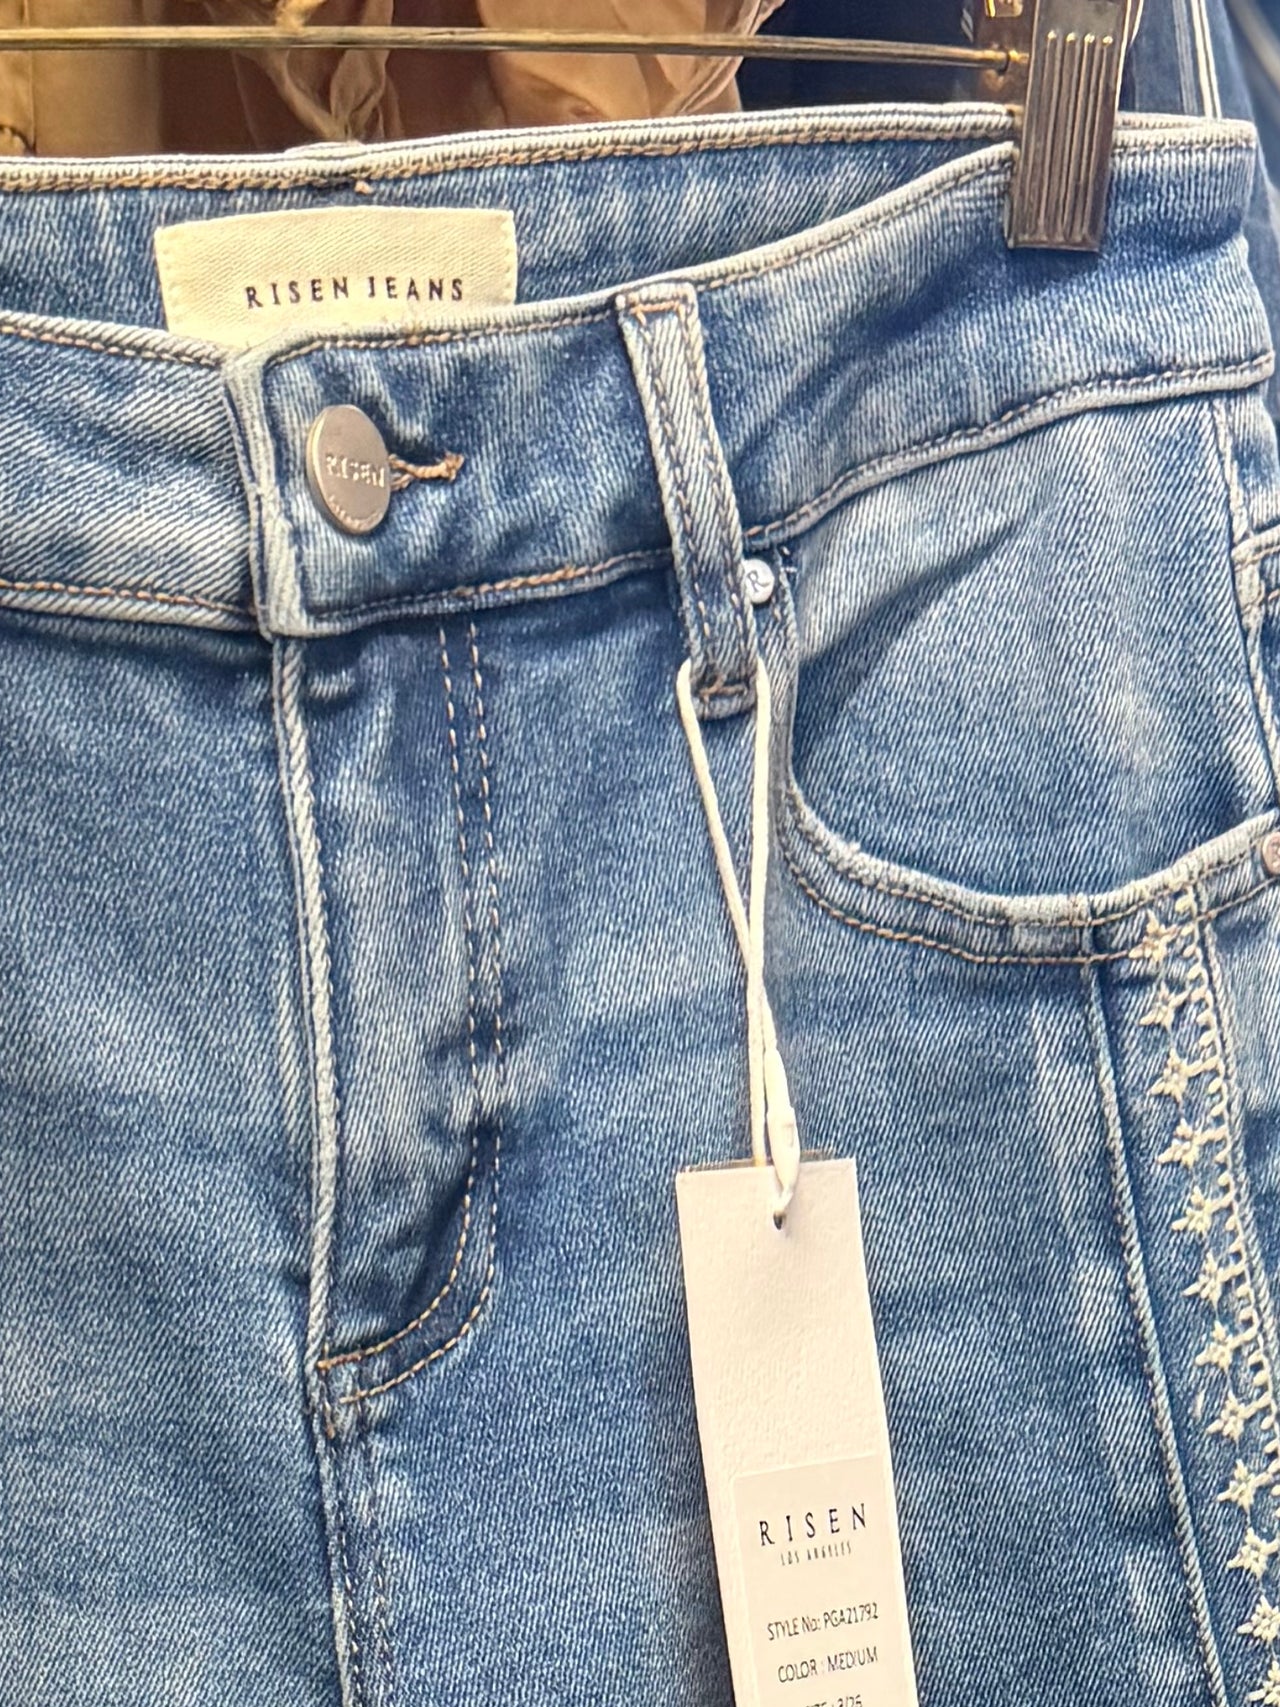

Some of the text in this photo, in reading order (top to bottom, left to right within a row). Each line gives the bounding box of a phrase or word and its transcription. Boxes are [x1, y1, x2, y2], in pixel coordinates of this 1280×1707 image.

[244, 275, 463, 310] RISEN JEANS
[758, 1502, 867, 1547] RISEN
[766, 1617, 799, 1641] STYLE
[777, 1658, 818, 1683] COLOR
[826, 1645, 879, 1672] MEDIUM
